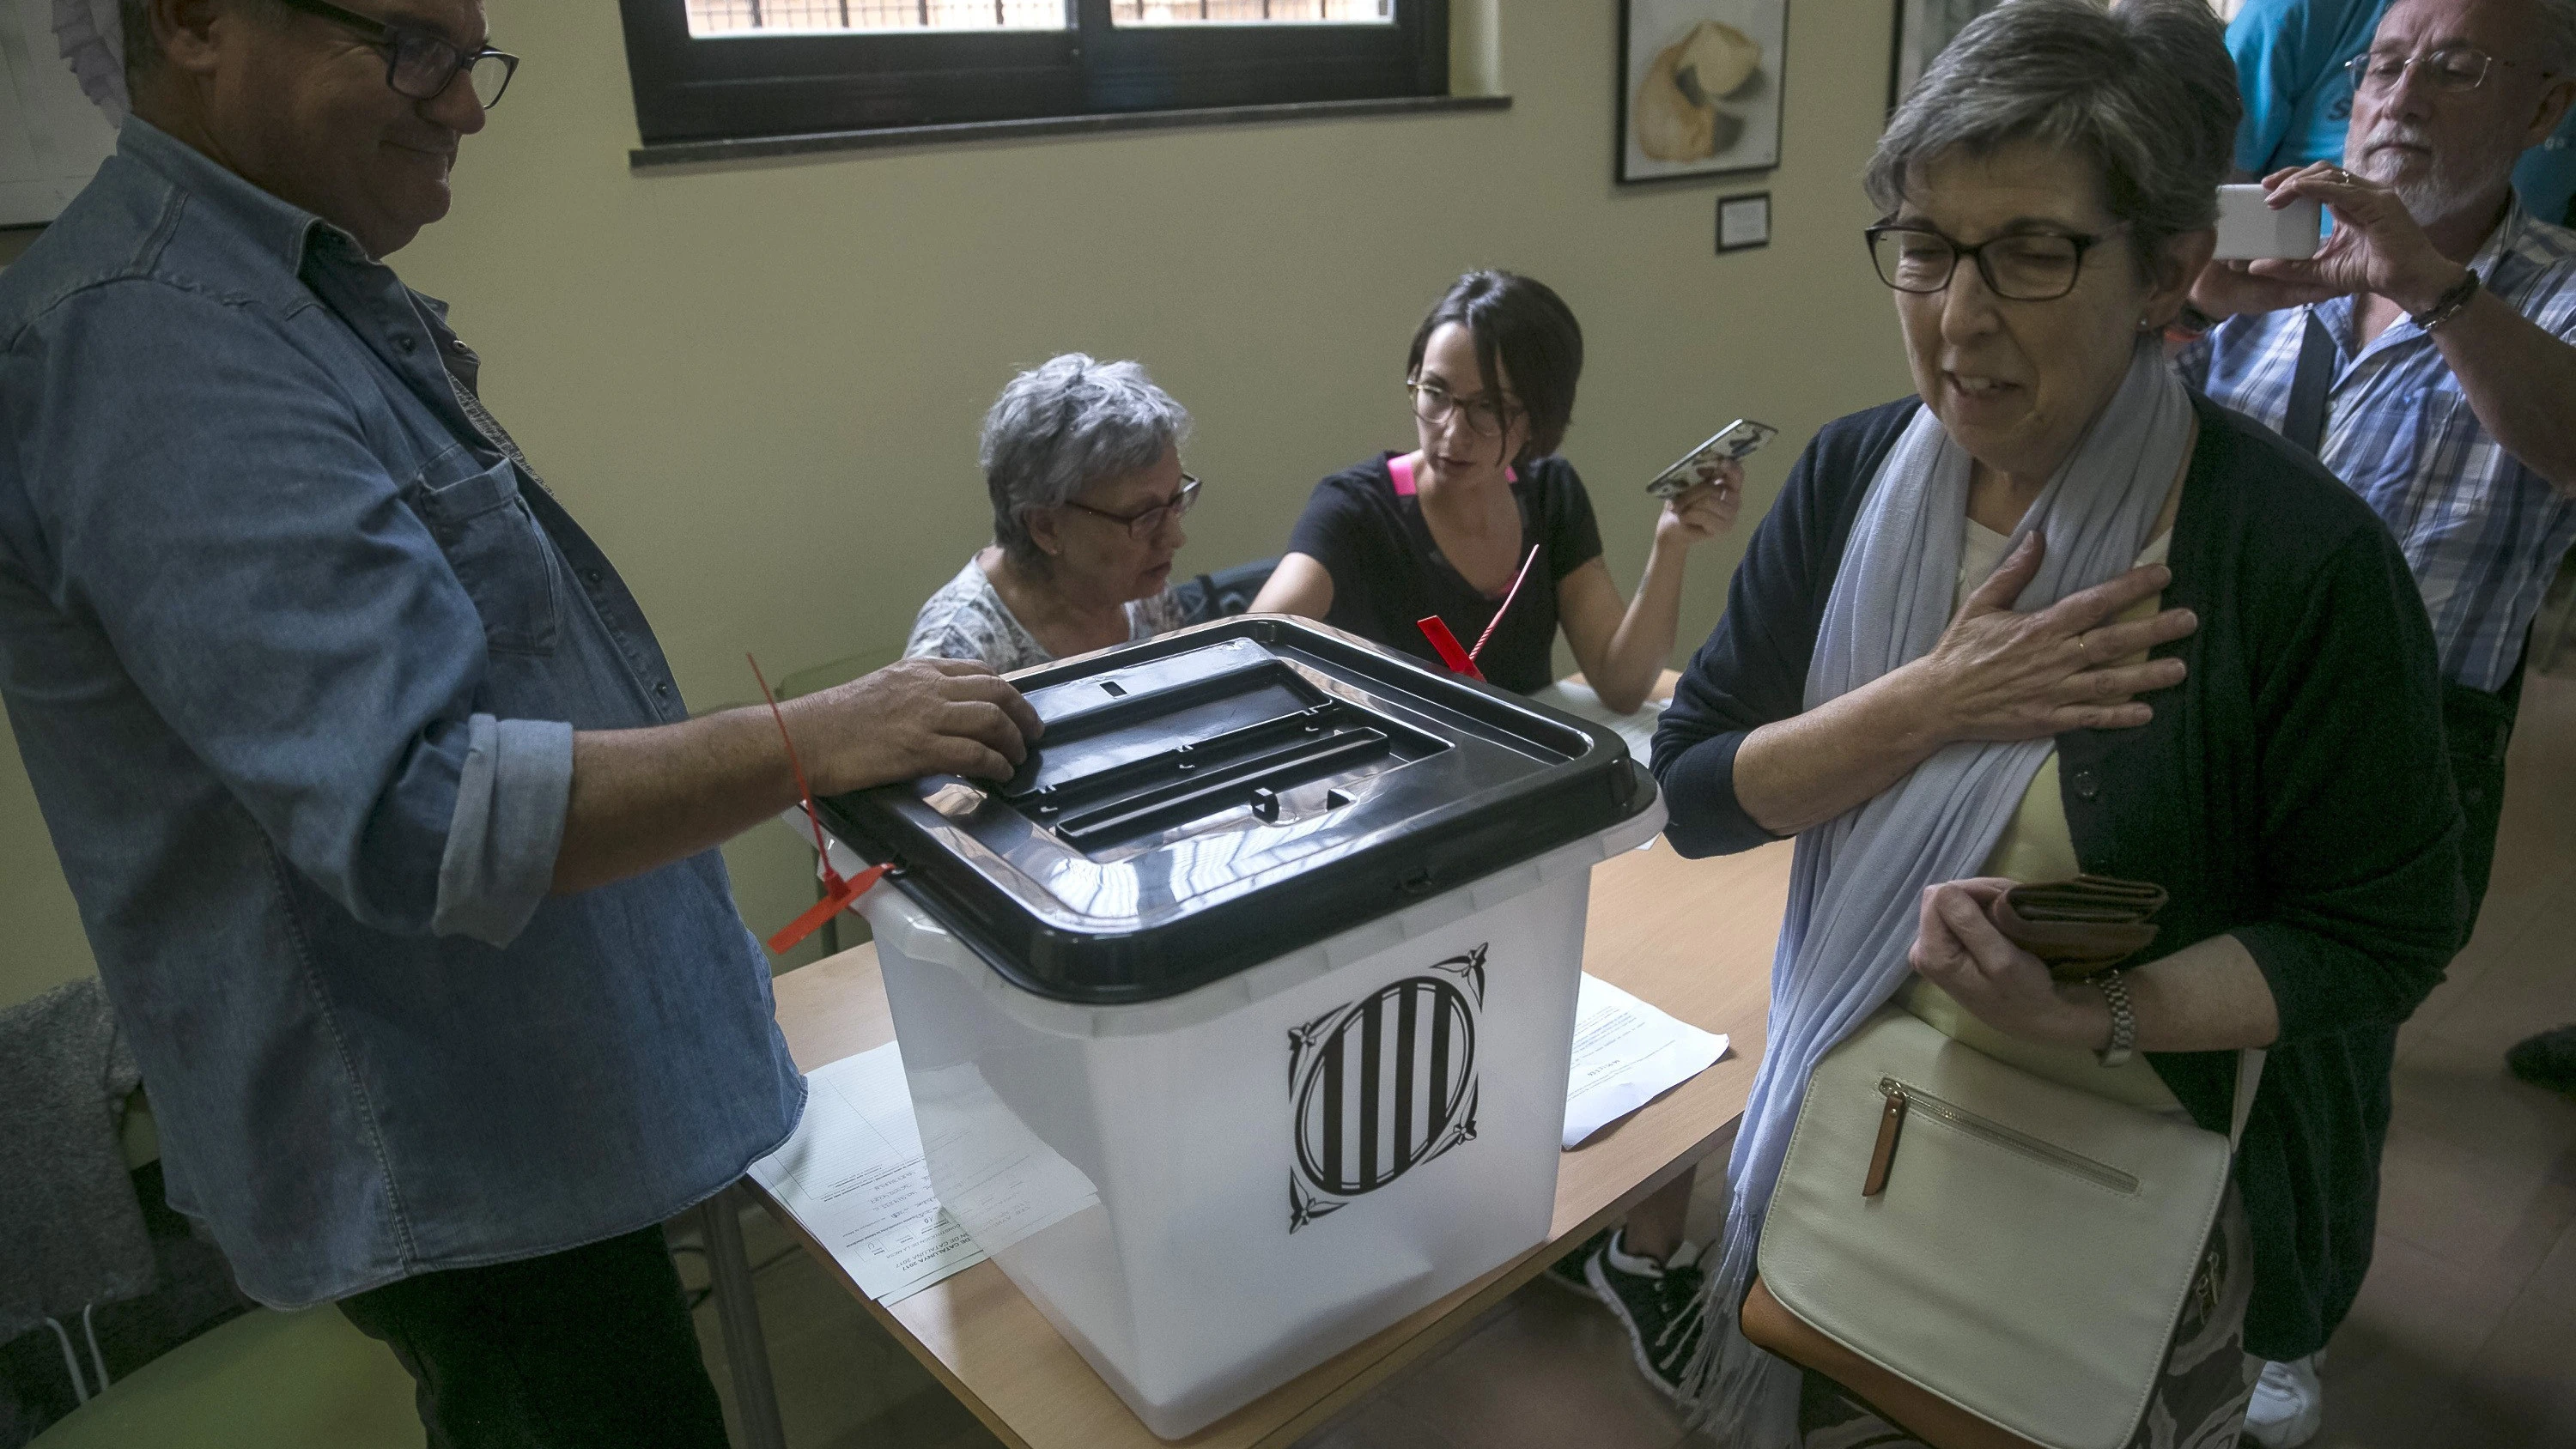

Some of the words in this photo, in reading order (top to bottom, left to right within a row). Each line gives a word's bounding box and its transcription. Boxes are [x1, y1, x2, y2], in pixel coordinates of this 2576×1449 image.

[960, 1236, 970, 1245] DE
[918, 1241, 960, 1264] CATALUNYA
[895, 1258, 910, 1268] 2017
[902, 1260, 917, 1270] 2017
